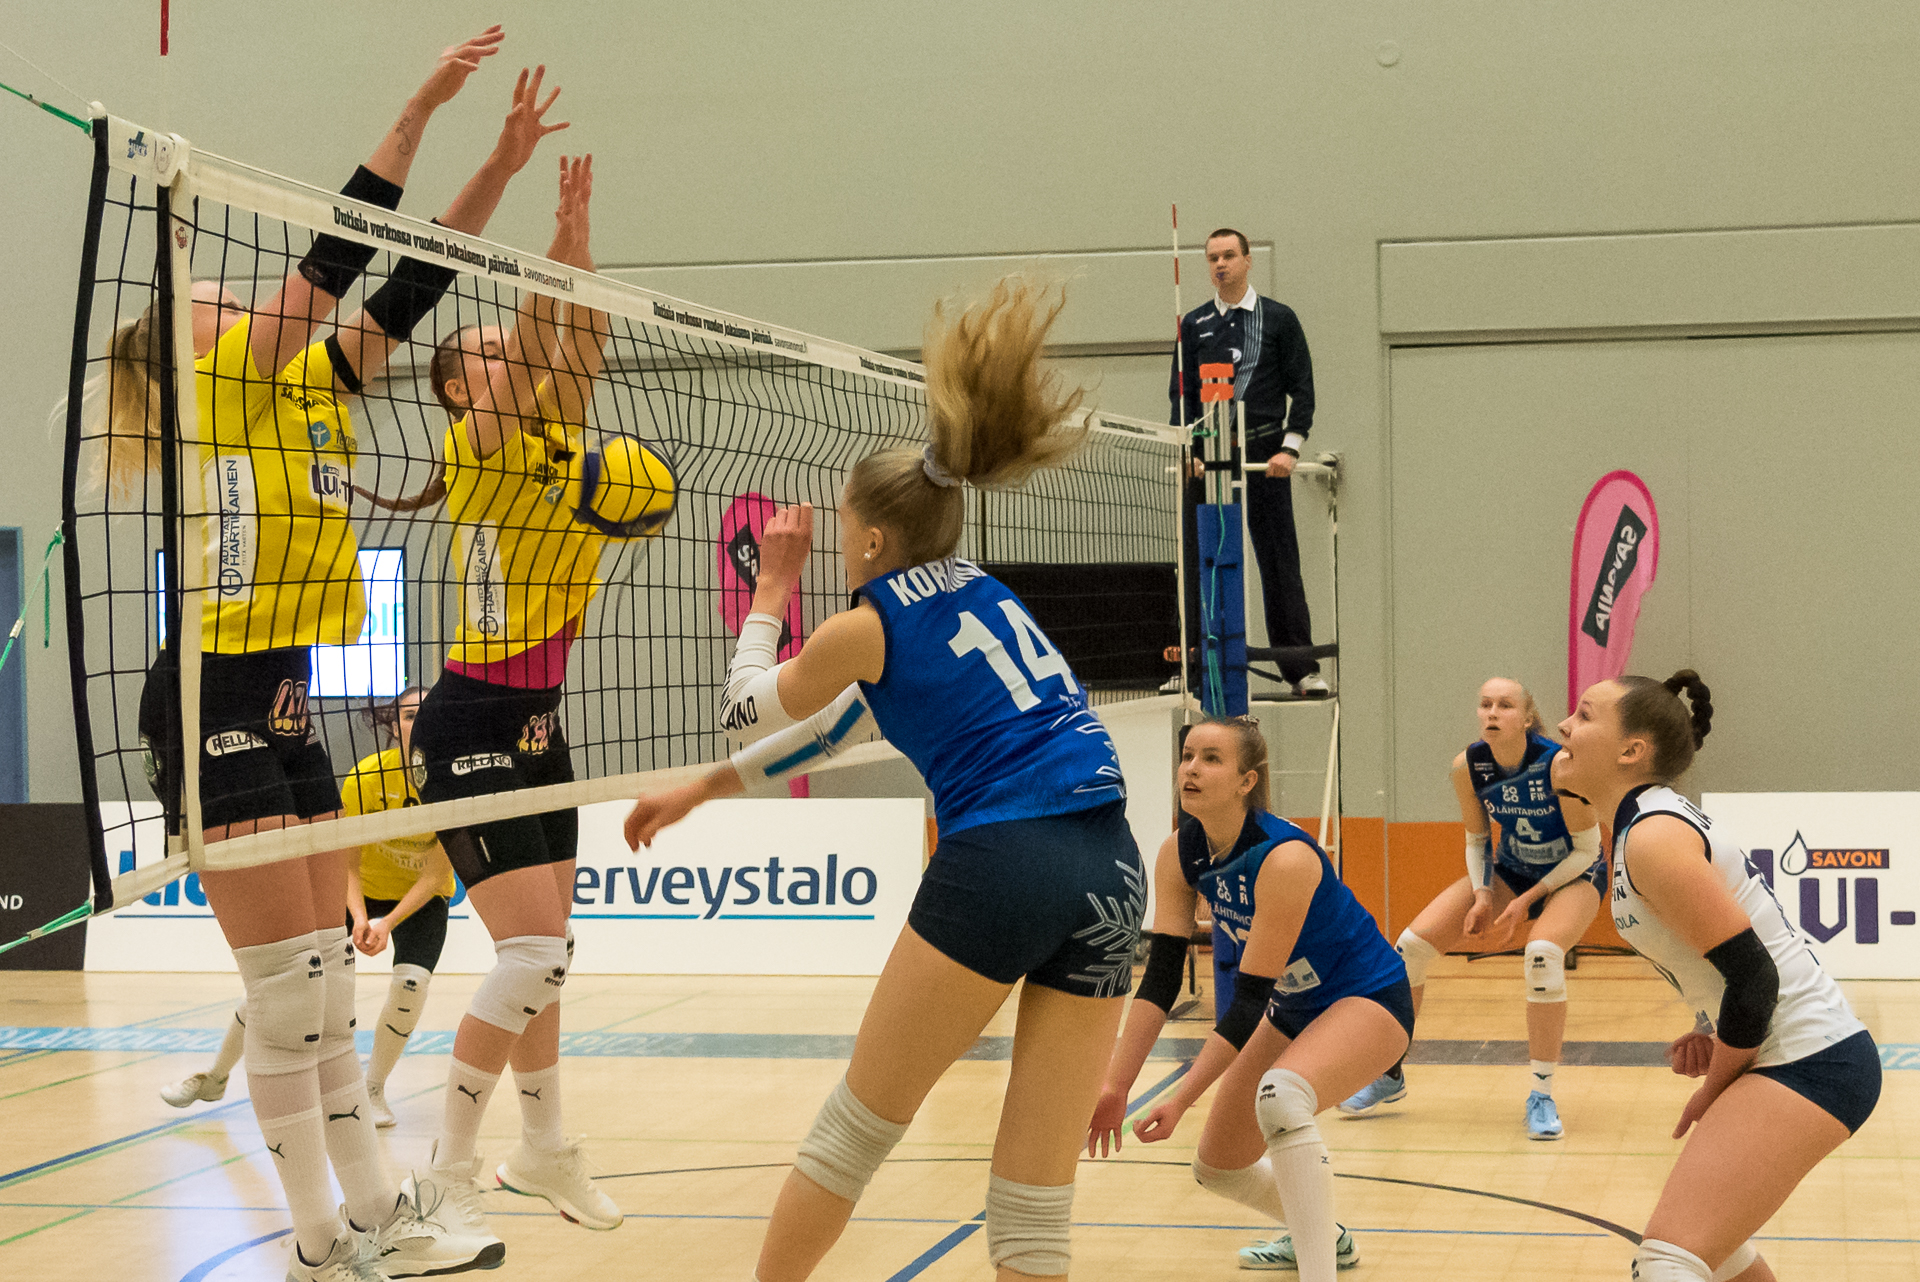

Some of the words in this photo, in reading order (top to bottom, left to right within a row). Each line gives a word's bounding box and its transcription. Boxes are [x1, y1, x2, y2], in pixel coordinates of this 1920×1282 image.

[333, 206, 368, 234] Uutisia
[370, 221, 412, 247] verkossa
[413, 233, 445, 256] vuoden
[445, 238, 487, 269] jokaisena
[488, 254, 521, 275] päivänä.
[523, 267, 575, 293] savonsanomat.fi
[226, 460, 240, 566] HARTIKAINEN
[948, 599, 1080, 713] 14
[1496, 804, 1556, 816] LÄHITAPIOLA
[1515, 817, 1543, 842] 4
[1811, 850, 1883, 868] SAVON
[0, 894, 23, 910] ND
[573, 853, 878, 920] erveystalo
